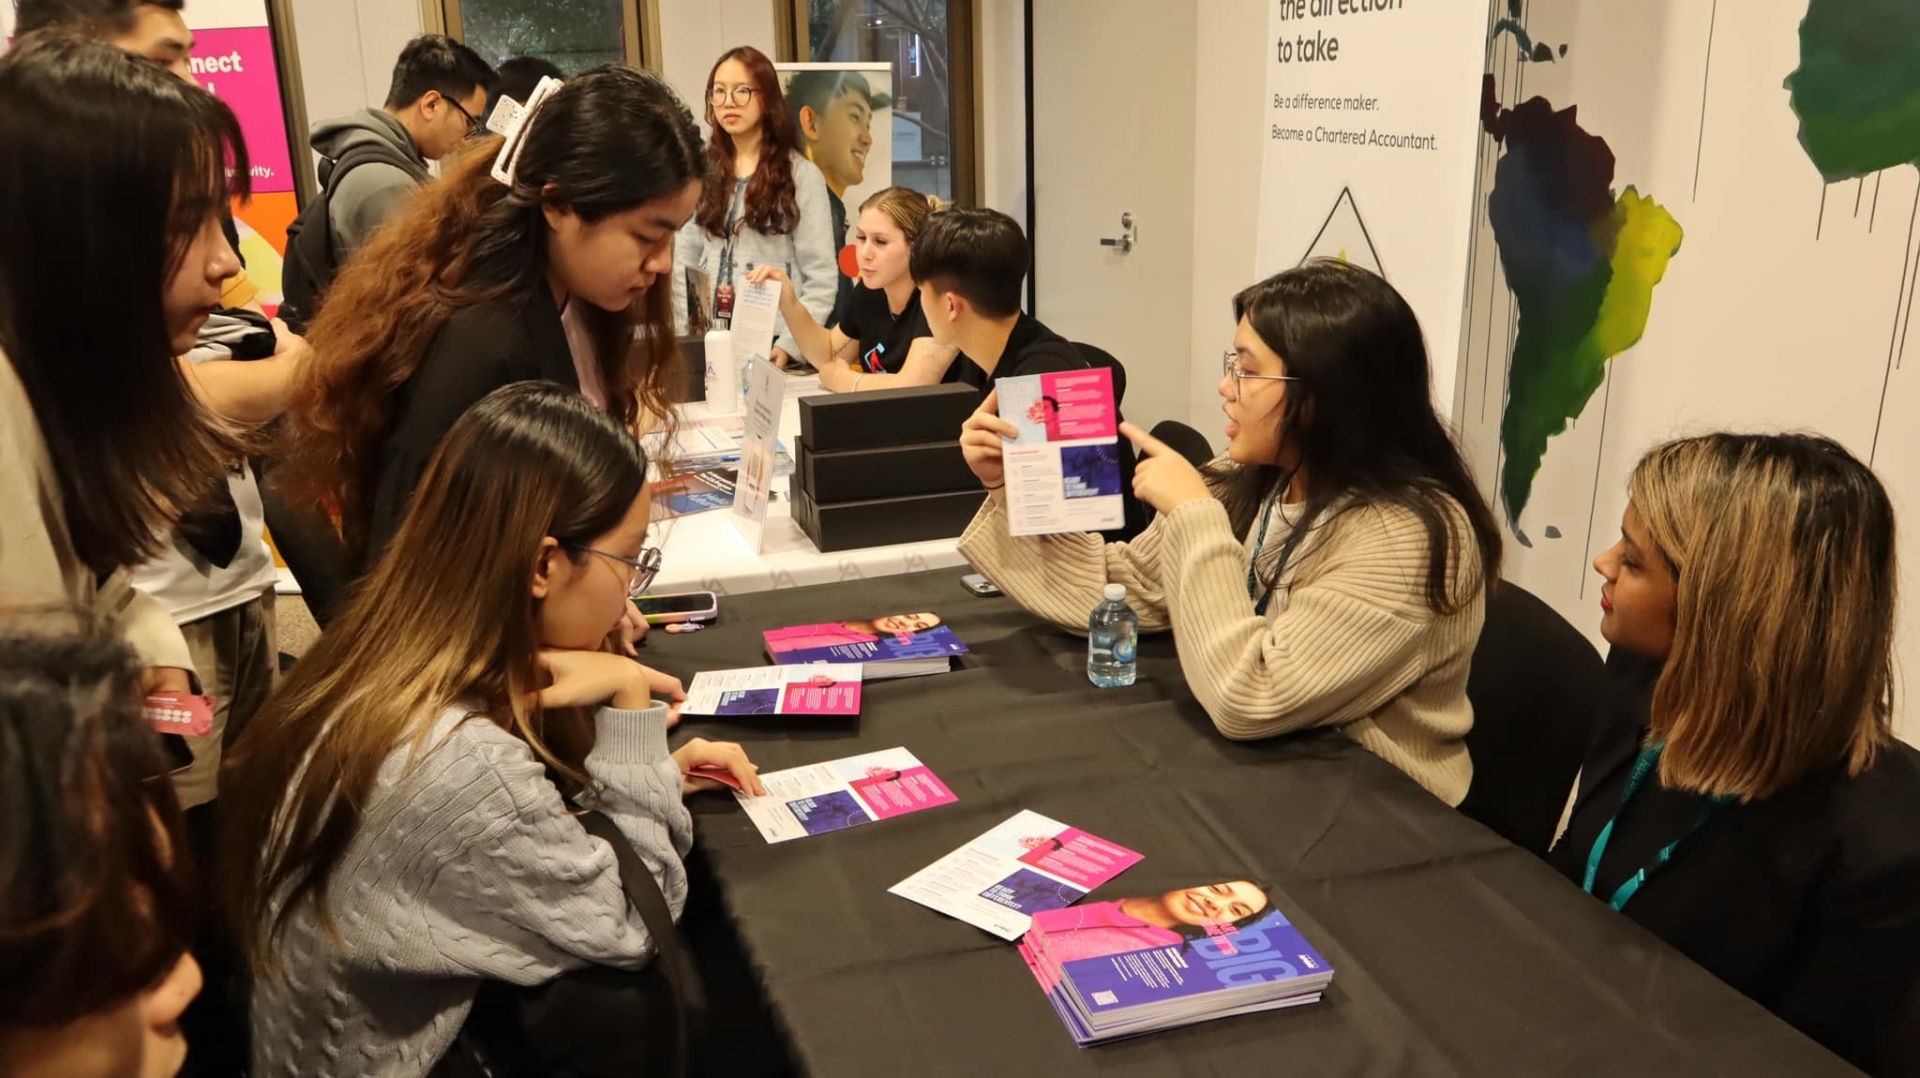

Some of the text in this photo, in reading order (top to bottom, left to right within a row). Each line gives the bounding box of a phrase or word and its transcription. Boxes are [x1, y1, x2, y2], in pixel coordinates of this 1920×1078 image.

[1280, 0, 1306, 21] the
[1277, 30, 1339, 63] to take
[187, 50, 244, 74] nect
[1274, 93, 1379, 111] Be a difference maker.
[1272, 124, 1438, 151] Become a Chartered Accountant.
[1189, 926, 1298, 989] BIG
